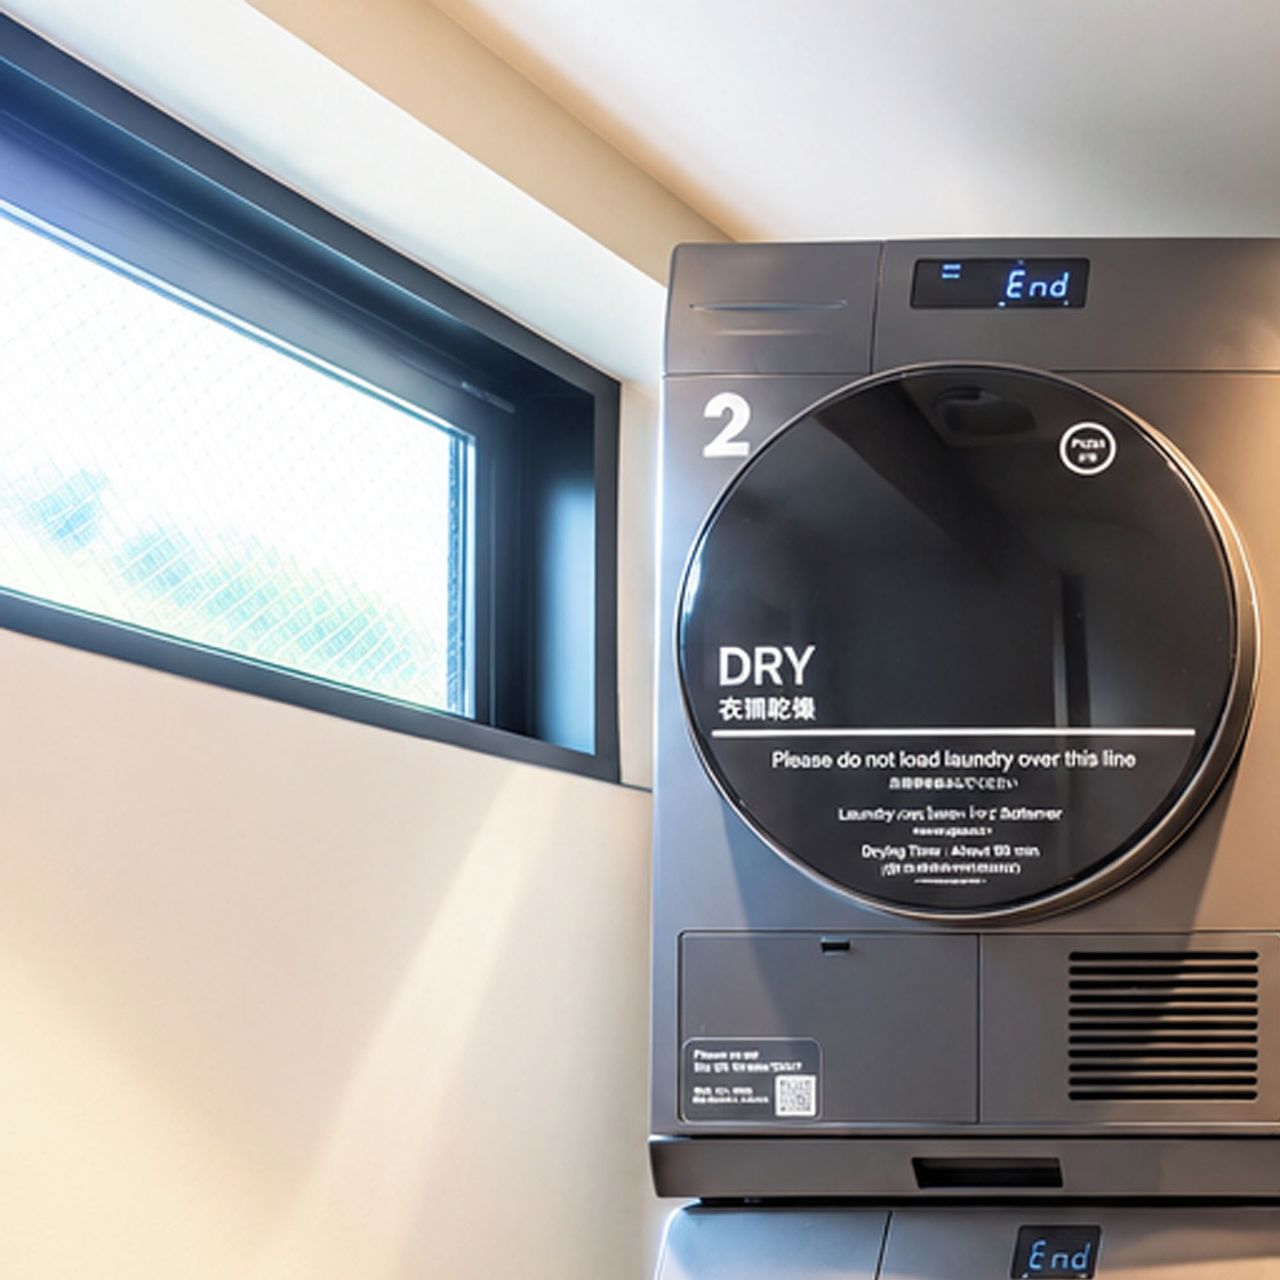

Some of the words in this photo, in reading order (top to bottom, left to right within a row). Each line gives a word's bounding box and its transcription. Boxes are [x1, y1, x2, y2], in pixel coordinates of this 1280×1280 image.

[1007, 270, 1068, 298] End
[703, 392, 750, 457] 2
[720, 646, 815, 686] DRY
[772, 750, 833, 768] Please
[837, 752, 861, 768] do
[865, 752, 895, 768] not
[900, 751, 940, 767] load
[945, 750, 1014, 772] laundry
[1018, 754, 1061, 767] over
[1065, 750, 1098, 767] this
[1103, 750, 1136, 767] line
[1029, 1240, 1098, 1273] End
